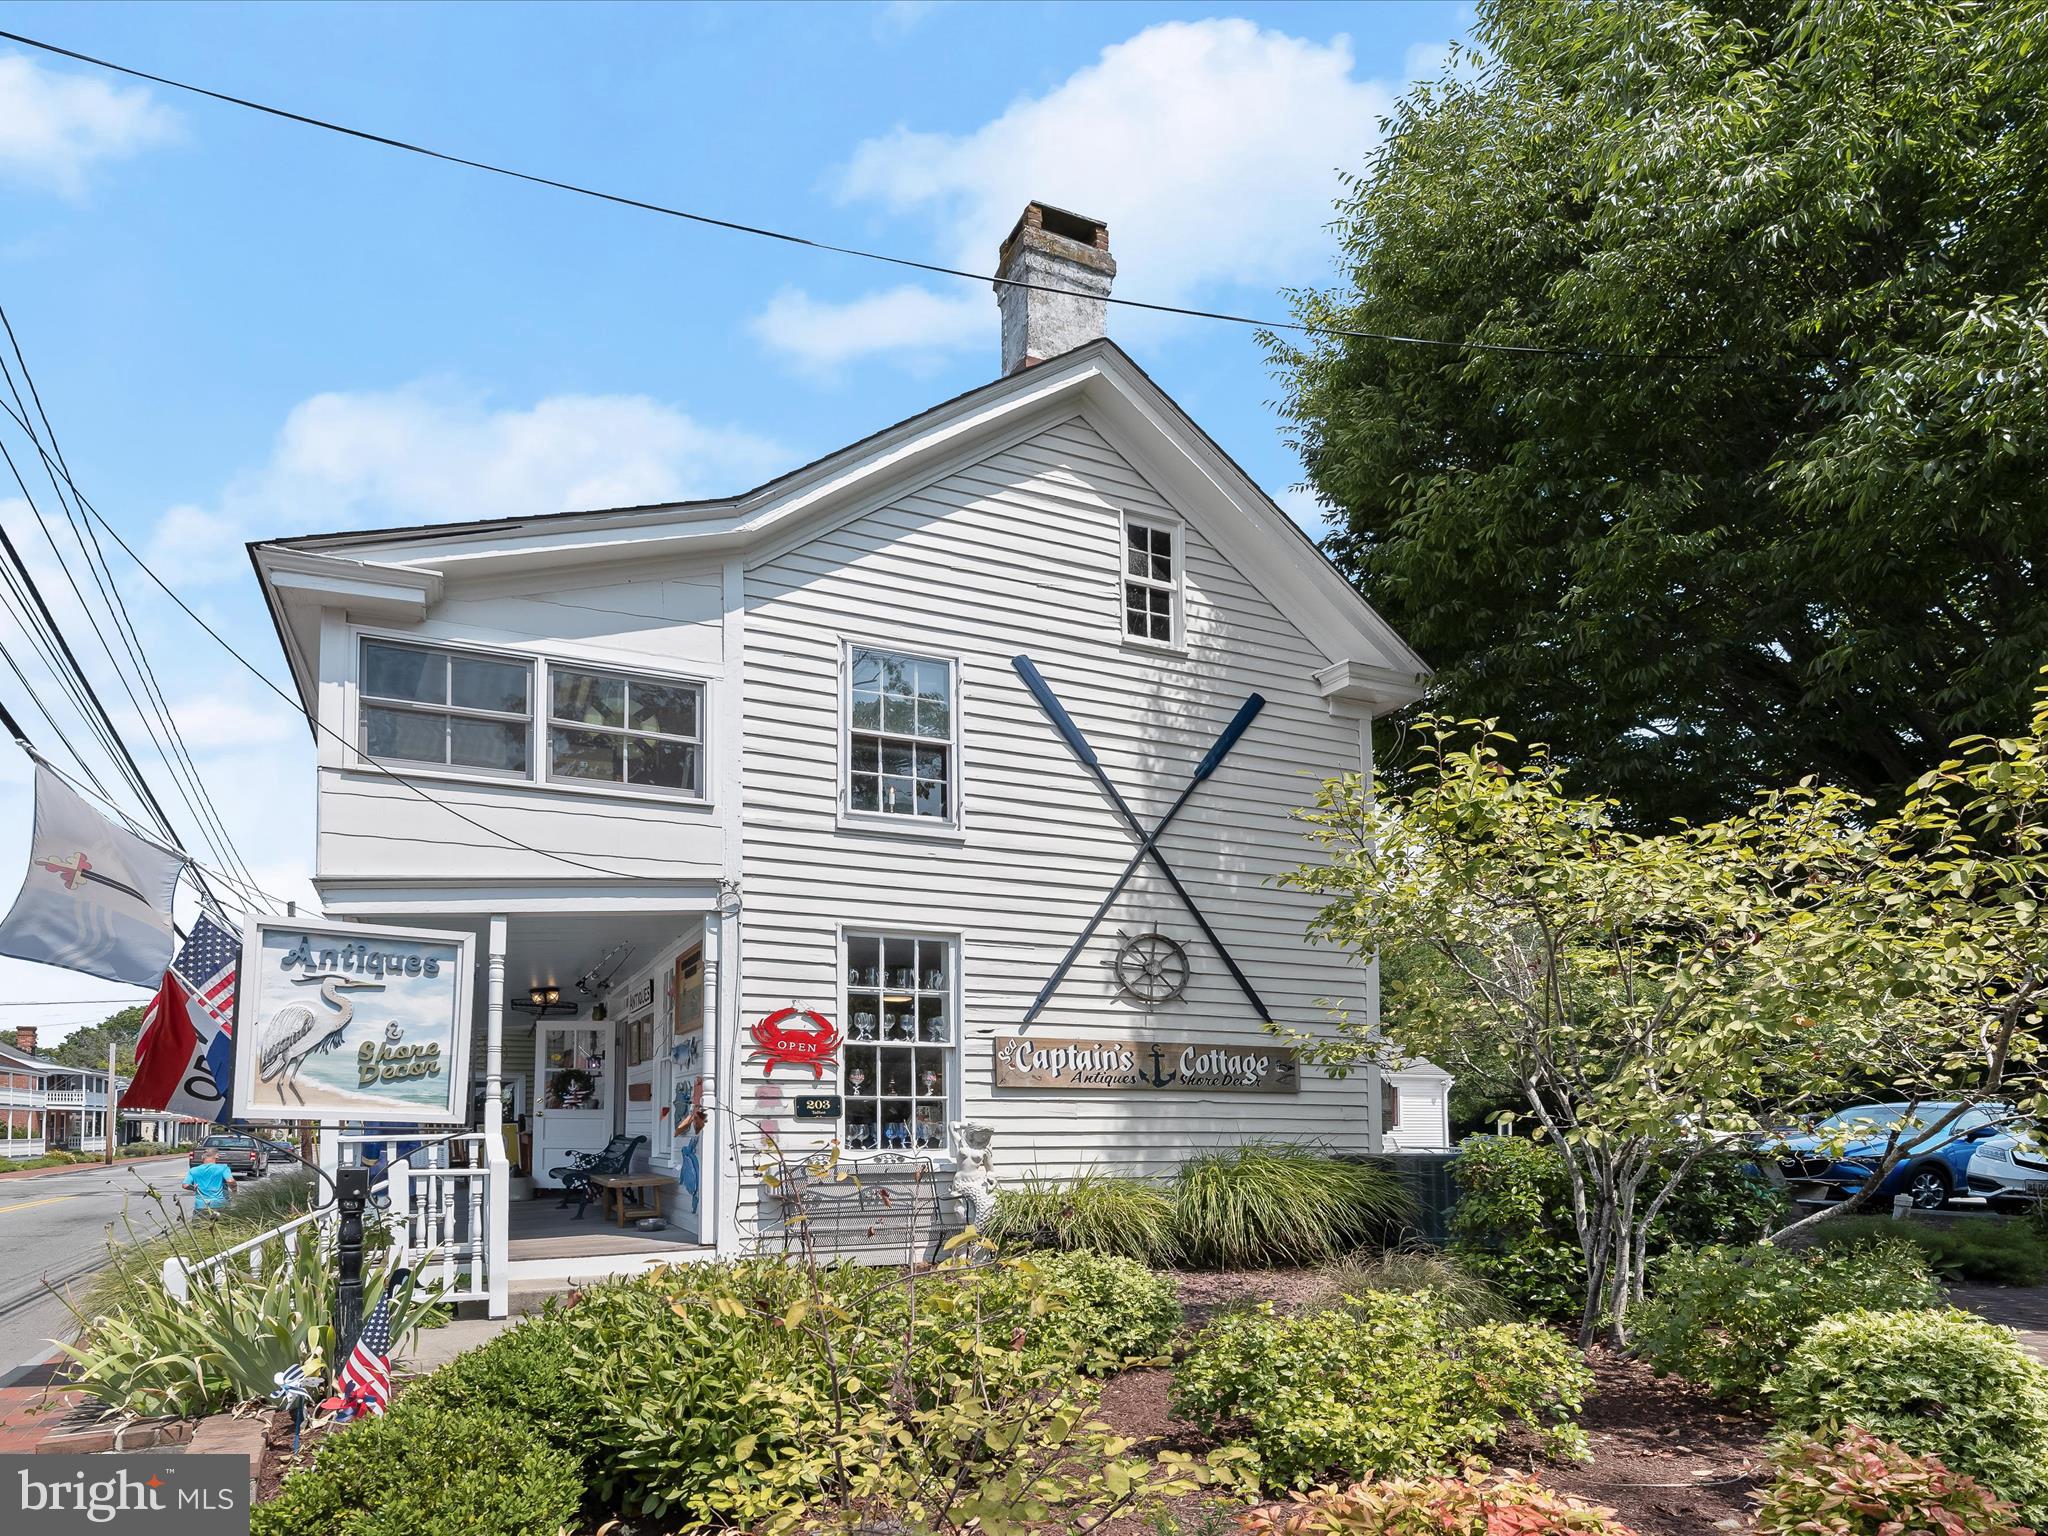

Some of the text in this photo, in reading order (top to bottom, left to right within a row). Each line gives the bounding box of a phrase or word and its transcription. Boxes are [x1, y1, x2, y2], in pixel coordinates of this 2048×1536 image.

[281, 936, 440, 979] Antiques
[385, 1020, 404, 1042] &
[358, 1040, 441, 1065] Shore
[777, 1040, 817, 1053] OPEN
[998, 1038, 1269, 1084] Sea Captain's Cottage
[358, 1061, 441, 1088] Decor
[1070, 1070, 1137, 1087] Antiques
[1180, 1072, 1220, 1087] Shore
[806, 1099, 831, 1110] 203
